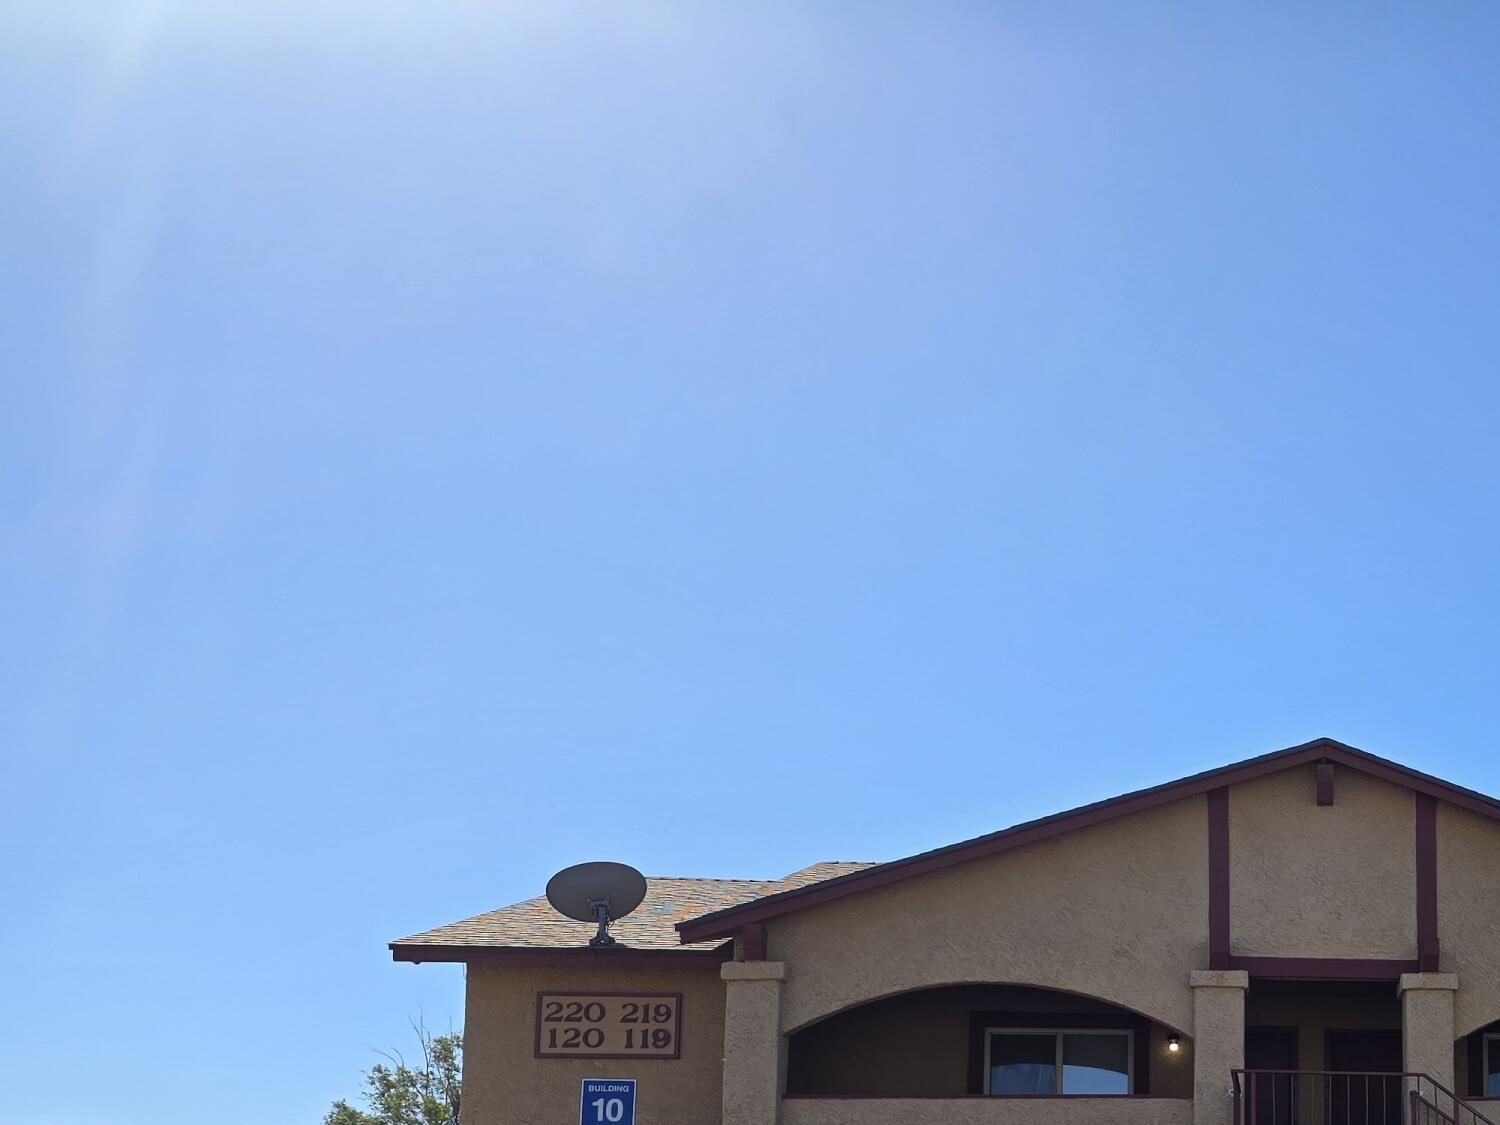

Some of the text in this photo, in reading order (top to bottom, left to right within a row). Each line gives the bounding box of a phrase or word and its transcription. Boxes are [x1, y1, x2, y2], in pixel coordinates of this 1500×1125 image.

[544, 1002, 672, 1024] 220 219
[548, 1027, 672, 1049] 120 119
[588, 1085, 629, 1093] BUILDING
[591, 1098, 624, 1122] 10
